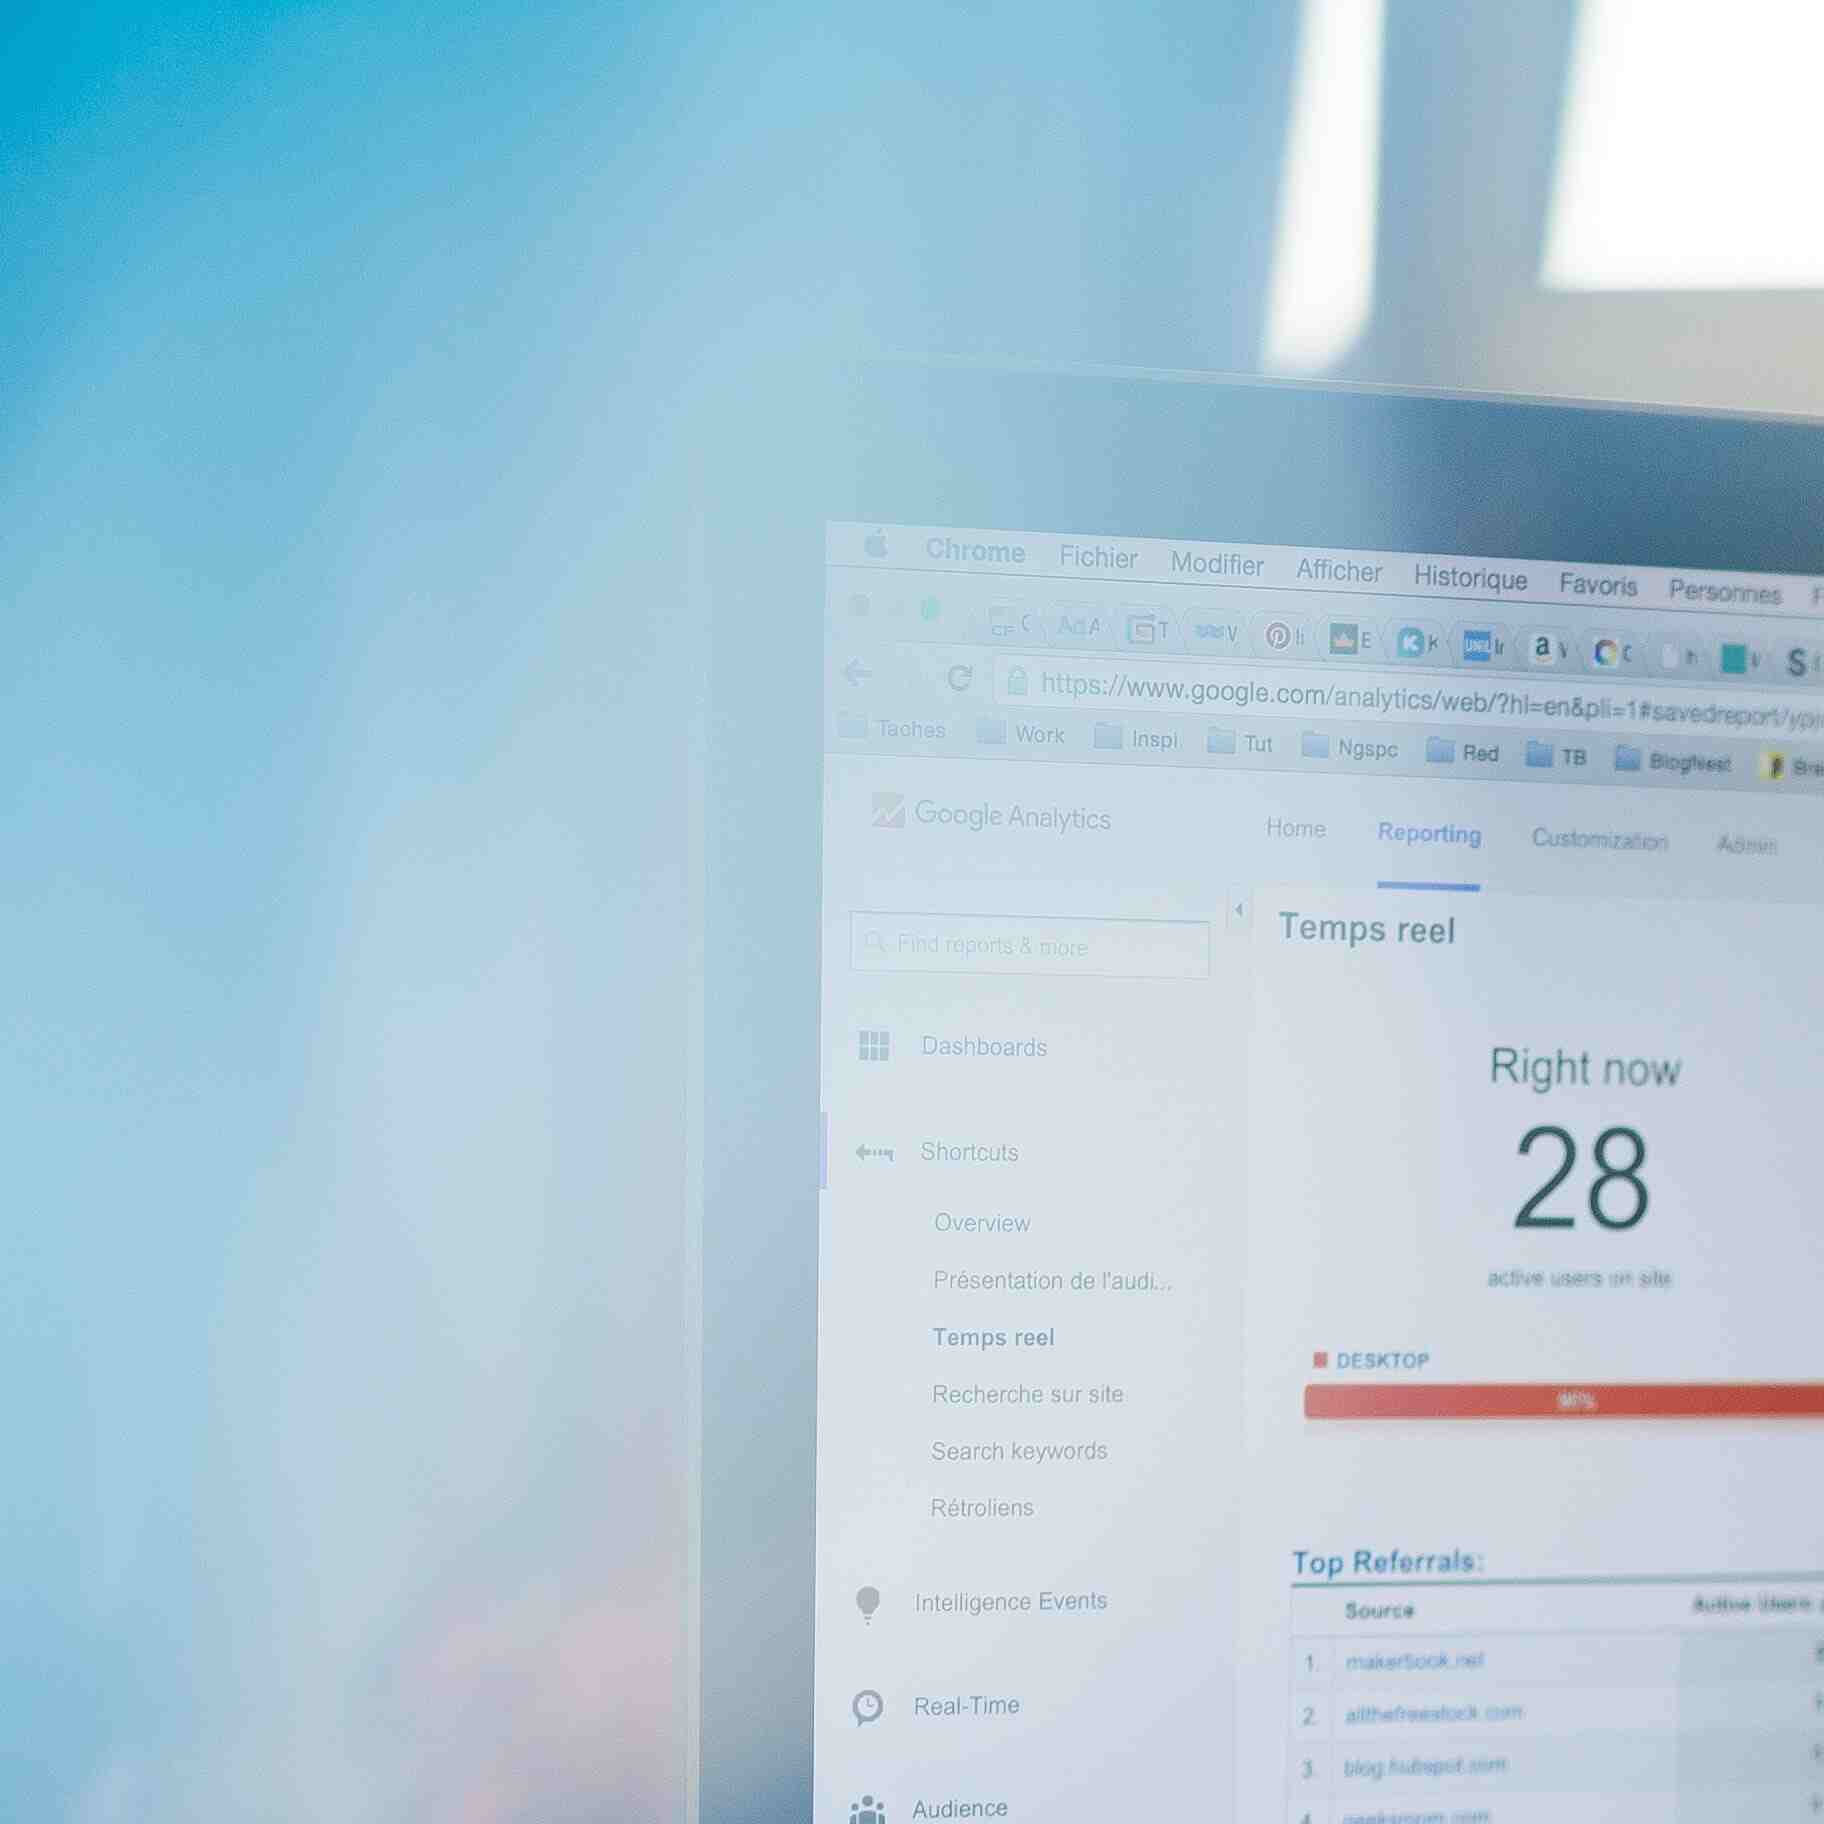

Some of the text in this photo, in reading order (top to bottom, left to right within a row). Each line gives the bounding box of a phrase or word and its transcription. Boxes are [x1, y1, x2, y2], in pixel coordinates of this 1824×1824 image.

[926, 538, 1025, 564] Chrome
[1060, 543, 1138, 570] Fichier
[1171, 550, 1264, 578] Modifier
[1296, 558, 1382, 584] Afficher
[1415, 563, 1528, 594] Historique
[1560, 572, 1637, 598] Favoris
[1670, 579, 1783, 606] Personnes
[1016, 724, 1065, 744] Work
[1245, 735, 1272, 752] Tut
[1464, 745, 1498, 762] Red
[915, 800, 1111, 834] Google Analytics
[1267, 817, 1326, 838] Home
[1378, 822, 1481, 849] Reporting
[1533, 827, 1669, 854] Customization
[1279, 911, 1455, 947] Temps reel
[923, 1036, 1047, 1057] Dashboards
[1491, 1047, 1681, 1093] Right now
[921, 1142, 1019, 1162] Shortcuts
[1514, 1125, 1650, 1230] 28
[935, 1212, 1031, 1233] Overview
[934, 1270, 1063, 1290] Présentation
[1071, 1272, 1094, 1290] de
[933, 1327, 1055, 1350] Temps reel
[1337, 1352, 1429, 1369] DESKTOP
[933, 1384, 1123, 1404] Recherche sur site
[931, 1441, 1108, 1463] Search keywords
[931, 1498, 1034, 1517] Rétroliens
[1293, 1548, 1485, 1580] Top Referrals:
[915, 1591, 1107, 1615] Intelligence Events
[1345, 1601, 1415, 1620] Source
[914, 1696, 1020, 1716] Real-Time
[912, 1800, 1008, 1820] Audience
